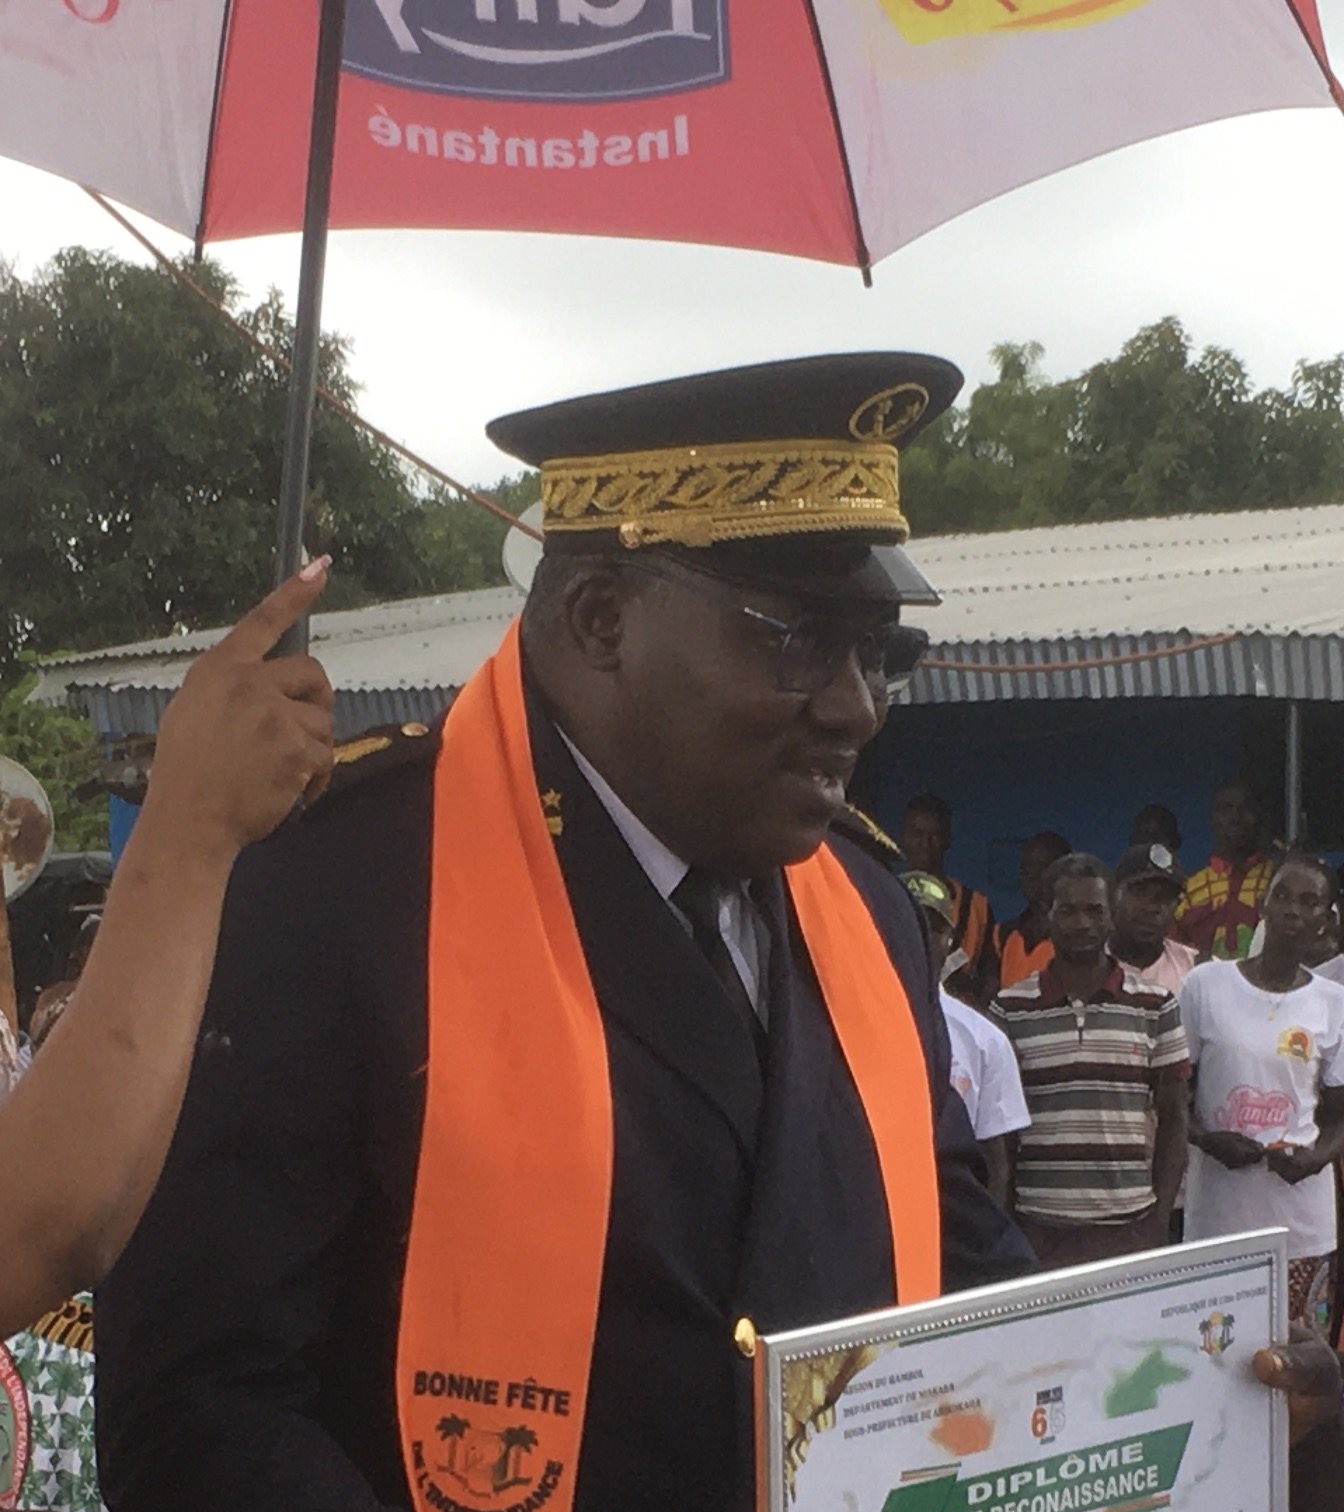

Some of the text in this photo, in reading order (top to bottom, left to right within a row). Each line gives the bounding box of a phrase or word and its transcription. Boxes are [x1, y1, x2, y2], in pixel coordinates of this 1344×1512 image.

[413, 1370, 571, 1417] BONNE FÊTE
[967, 1441, 1145, 1506] DIPLÔME
